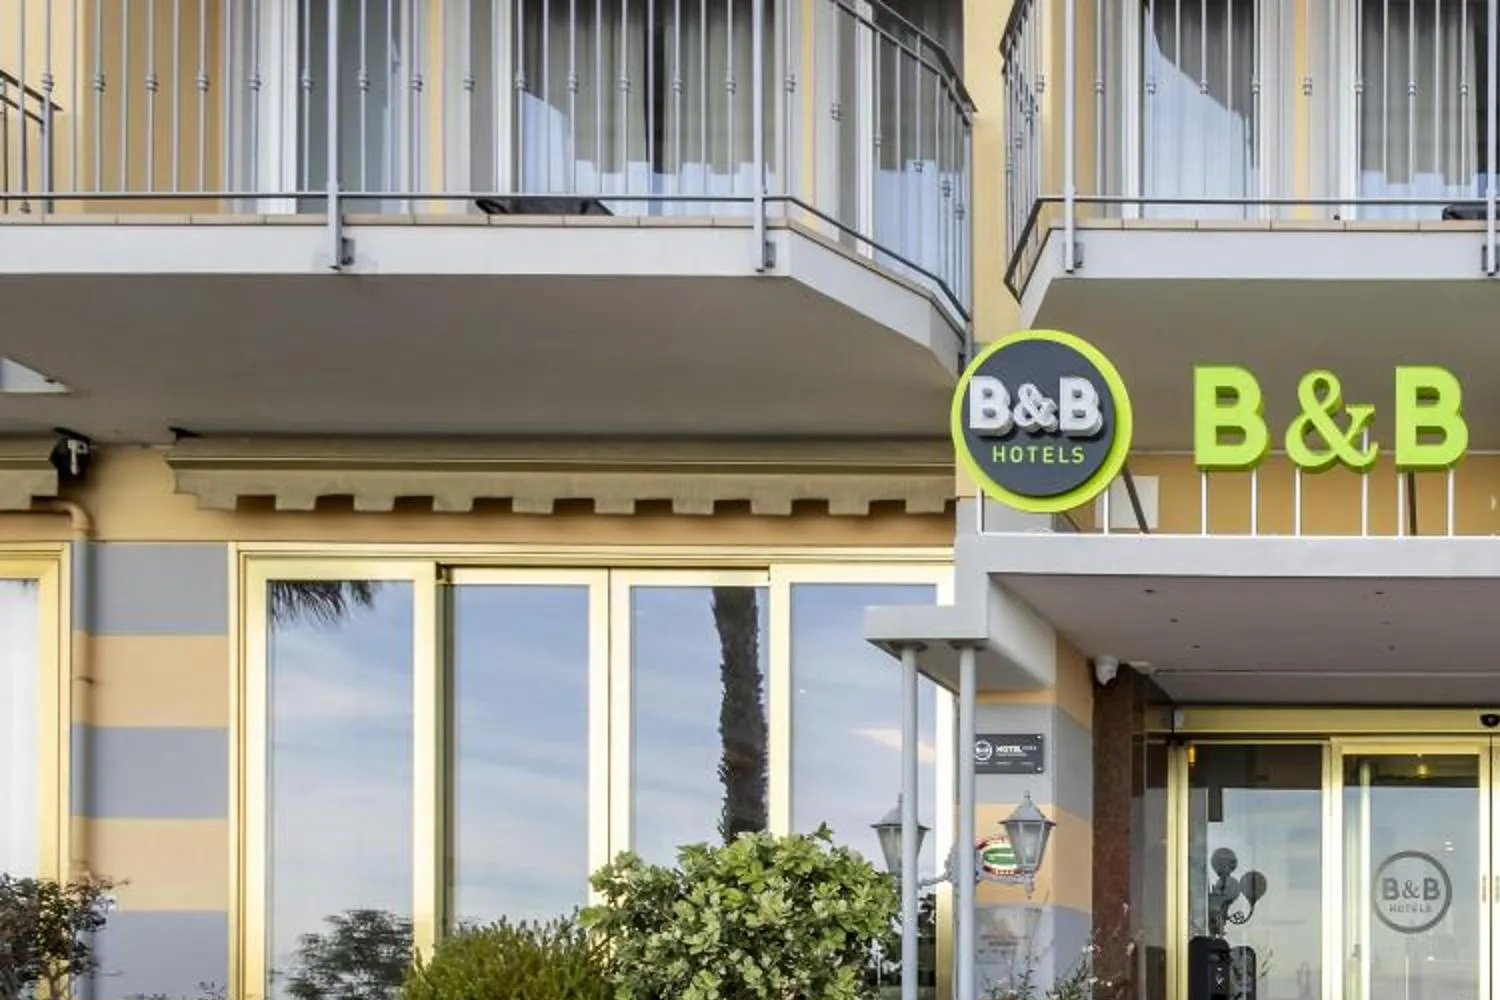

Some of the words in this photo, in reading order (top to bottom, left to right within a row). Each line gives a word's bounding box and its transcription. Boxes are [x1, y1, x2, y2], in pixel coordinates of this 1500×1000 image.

[969, 375, 1104, 437] B&B
[1193, 365, 1469, 473] B&B
[991, 445, 1086, 464] HOTELS
[1382, 877, 1441, 901] B&B
[1389, 903, 1432, 913] HOTELS
